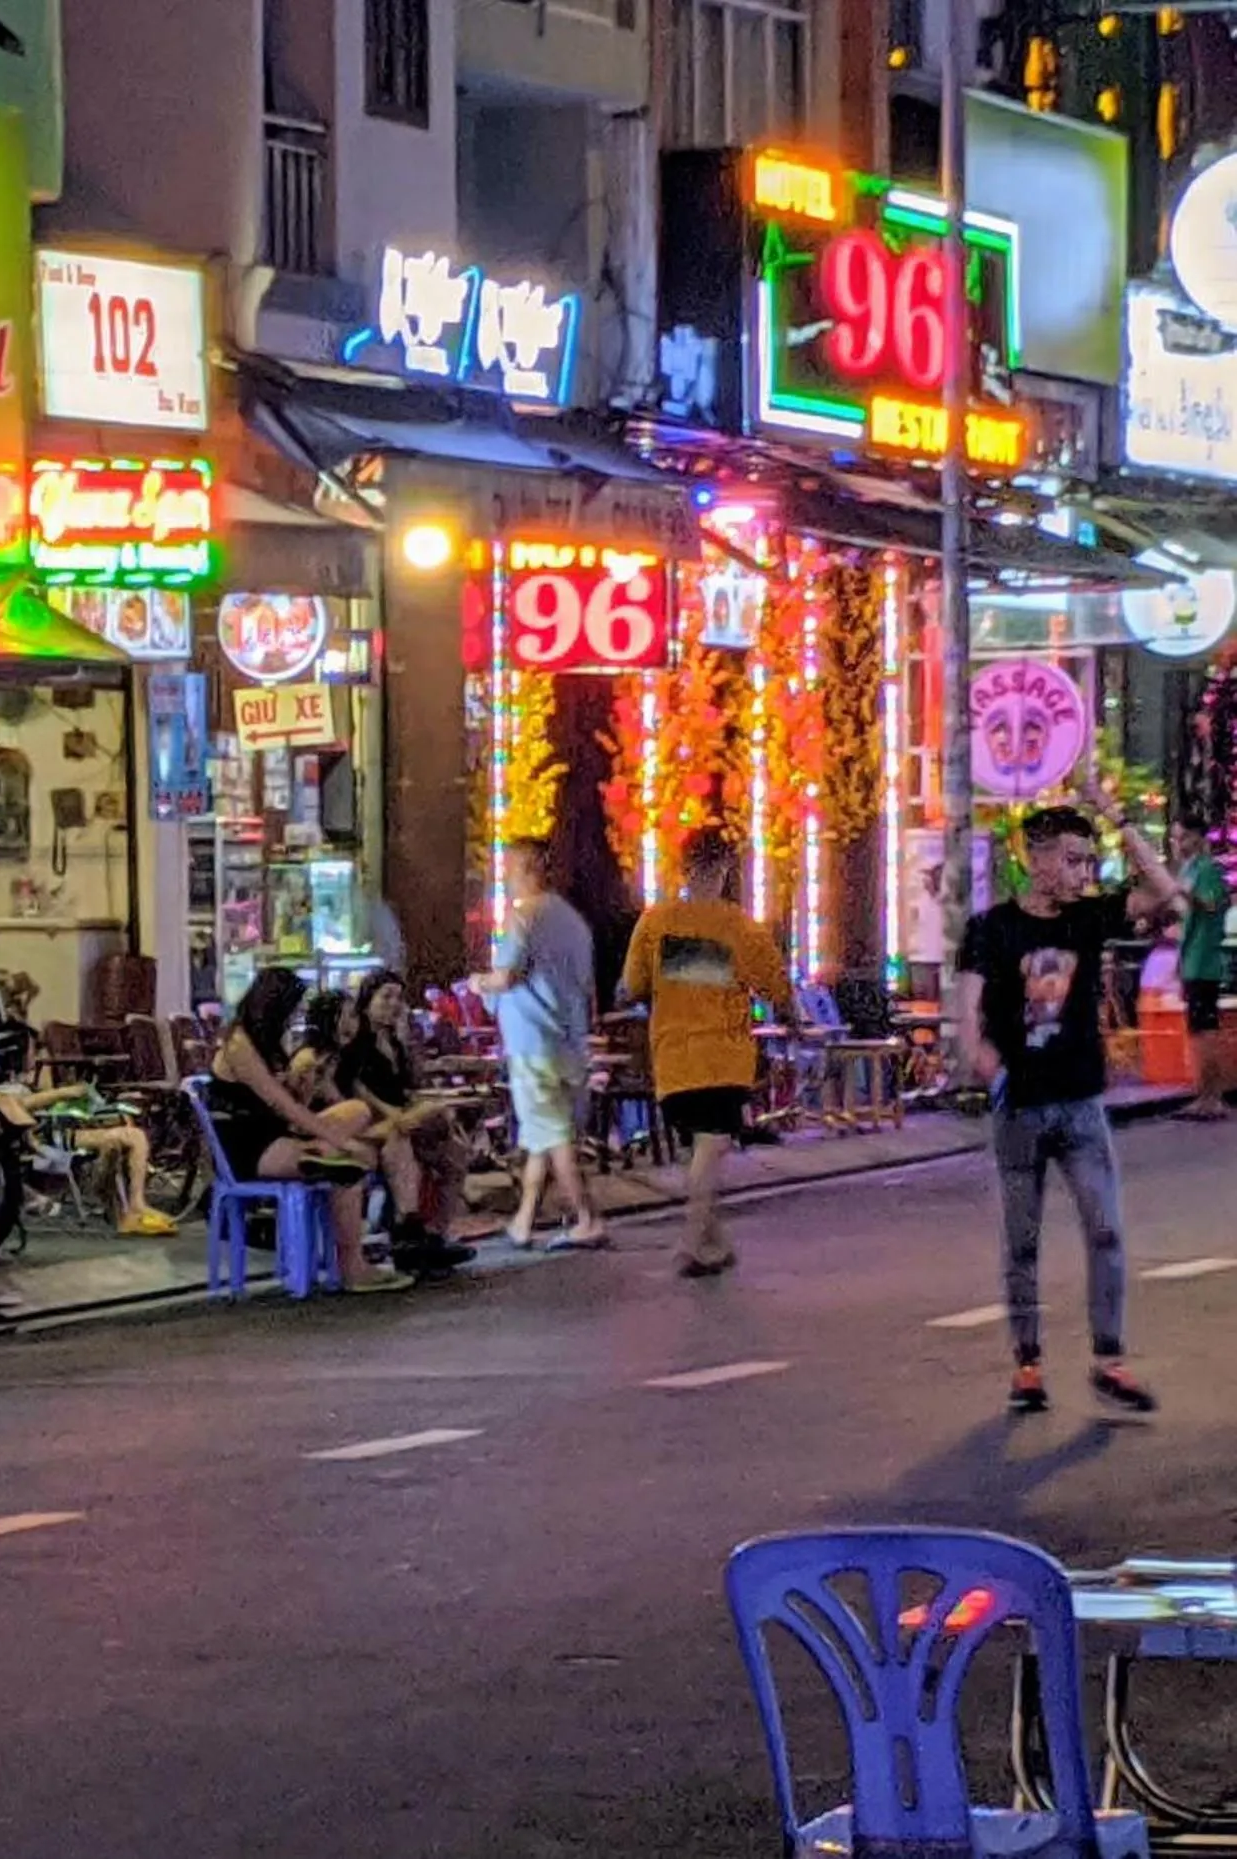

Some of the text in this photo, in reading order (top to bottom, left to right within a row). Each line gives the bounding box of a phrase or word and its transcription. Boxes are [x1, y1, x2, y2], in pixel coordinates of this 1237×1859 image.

[88, 292, 157, 377] 102
[833, 237, 948, 386] 96
[515, 574, 655, 661] 96
[295, 694, 324, 720] XE
